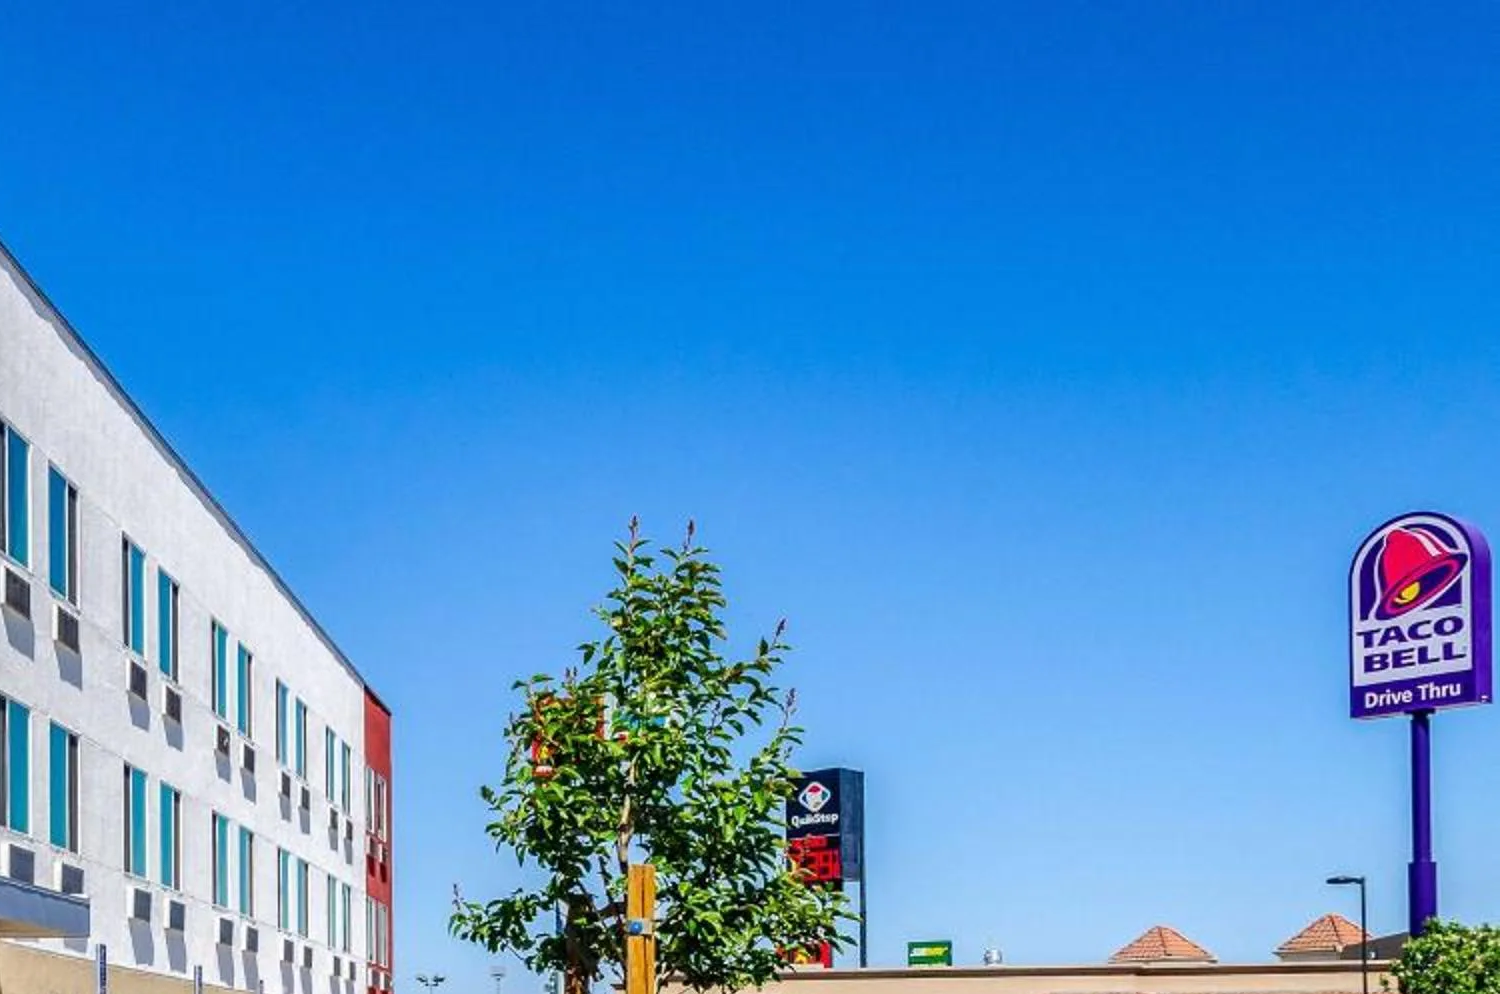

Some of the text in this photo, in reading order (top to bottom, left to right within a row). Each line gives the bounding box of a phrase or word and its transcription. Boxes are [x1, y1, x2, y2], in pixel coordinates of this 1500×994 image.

[1356, 615, 1464, 649] TACO
[1363, 641, 1467, 673] BELL
[1364, 682, 1461, 709] Drive Thru
